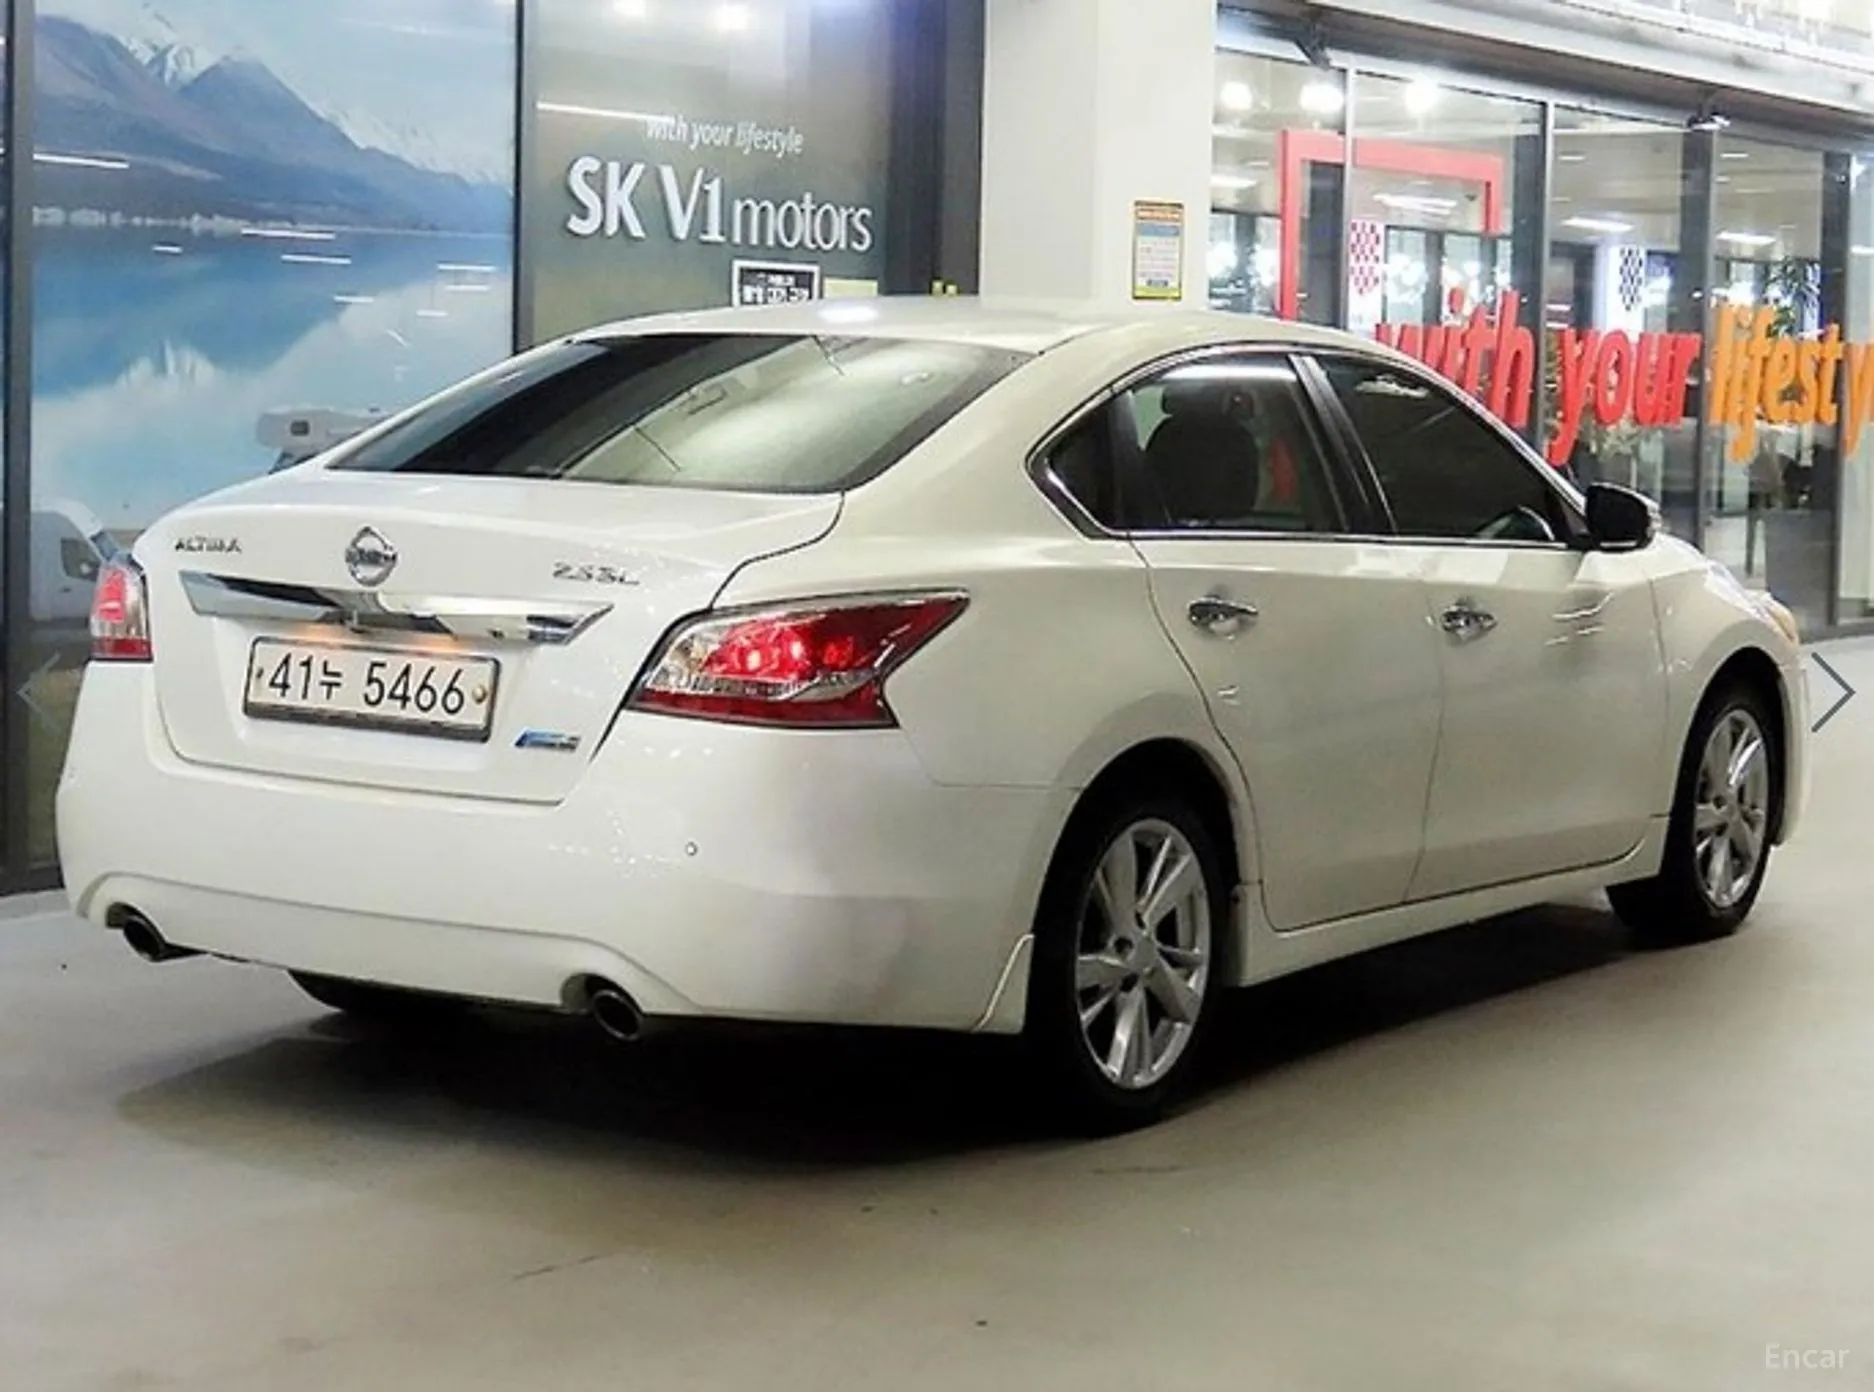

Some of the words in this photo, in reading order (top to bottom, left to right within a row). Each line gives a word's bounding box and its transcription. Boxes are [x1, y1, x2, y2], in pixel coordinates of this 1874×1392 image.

[646, 113, 689, 142] with
[689, 121, 734, 150] your
[735, 121, 804, 159] lifestyle
[566, 155, 646, 240] SK
[658, 164, 727, 243] V1
[731, 191, 872, 252] motors
[1544, 327, 1702, 467] your
[268, 652, 343, 700] 41누
[364, 660, 466, 715] 5466
